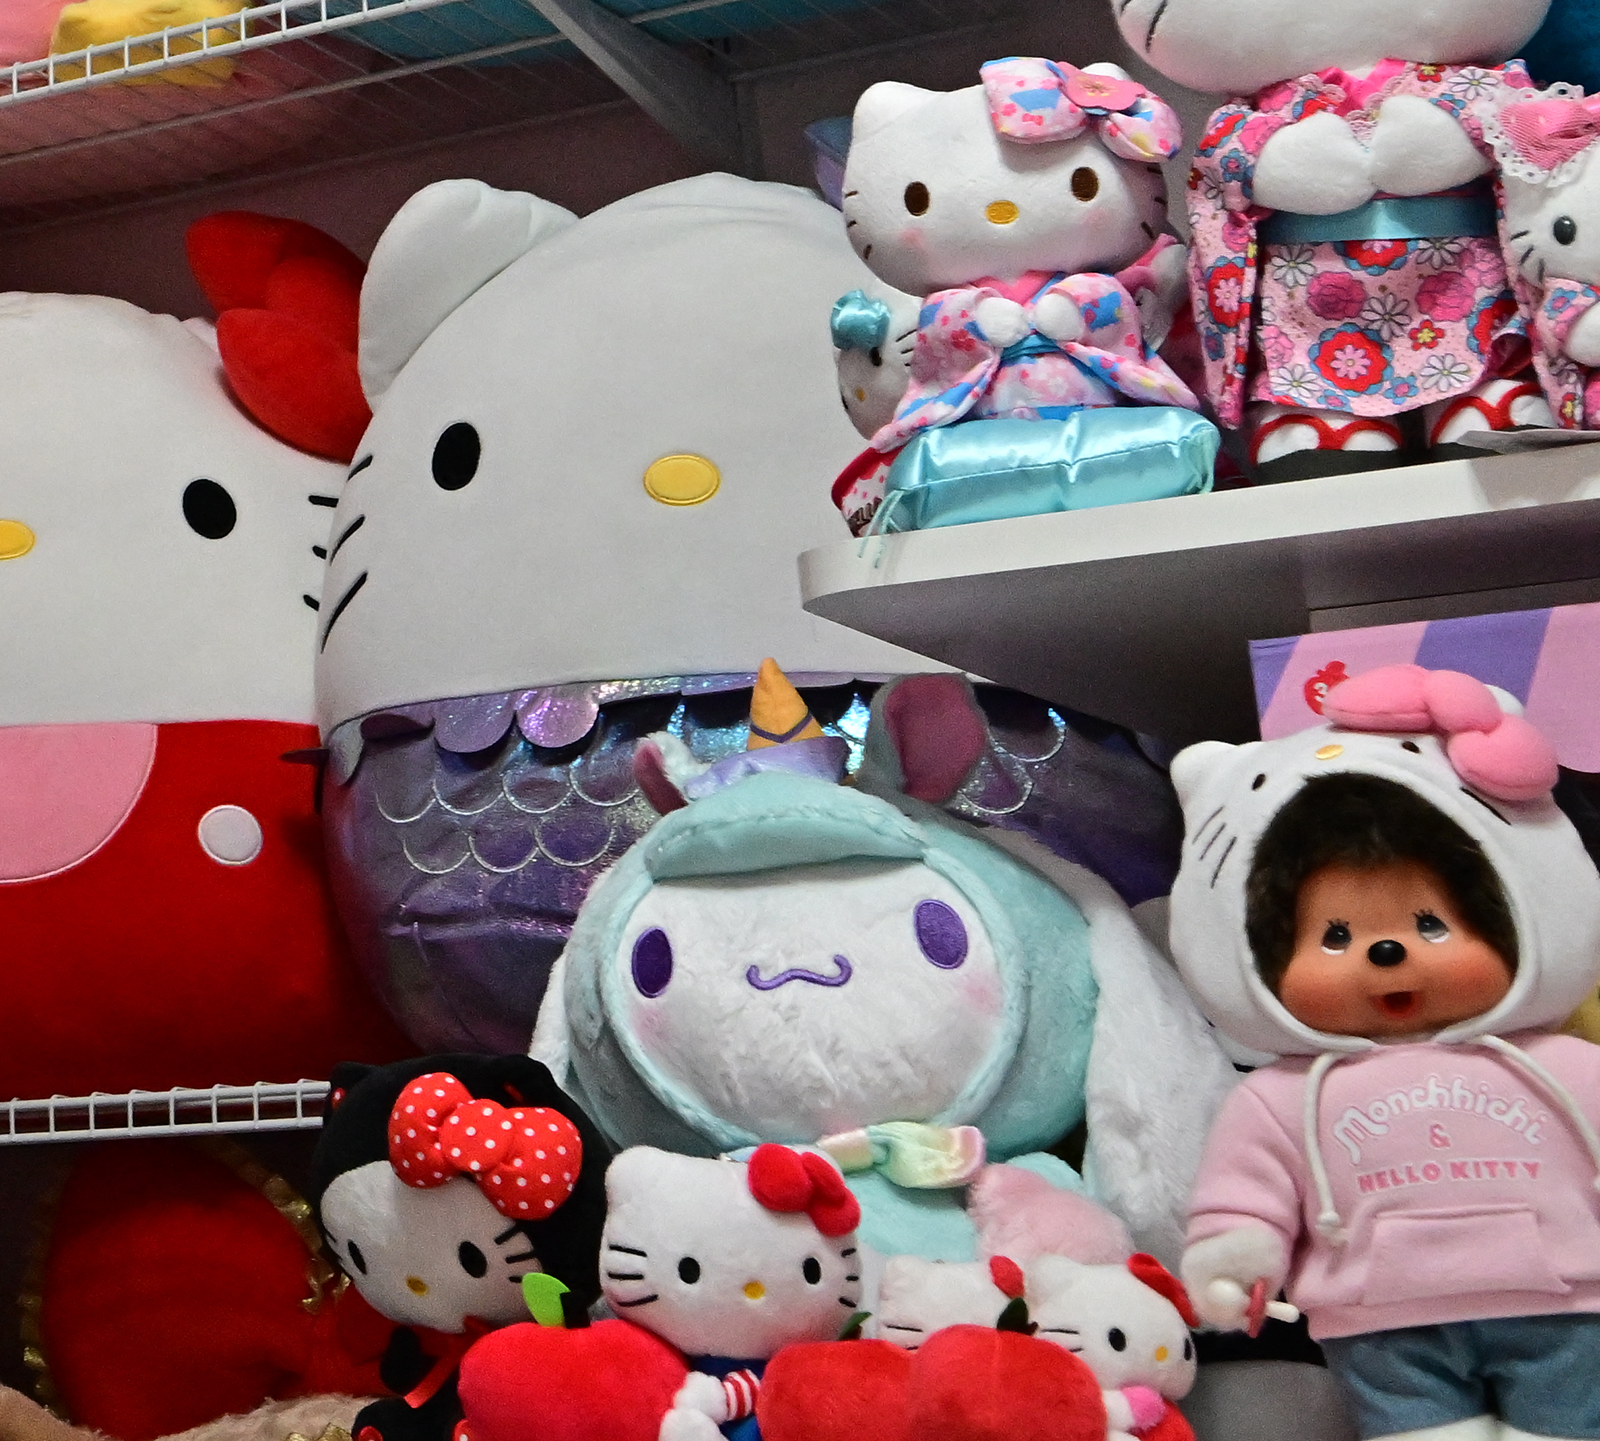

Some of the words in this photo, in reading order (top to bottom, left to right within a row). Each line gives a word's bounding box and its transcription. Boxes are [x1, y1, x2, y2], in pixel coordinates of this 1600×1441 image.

[1334, 1075, 1549, 1166] Monchhichi
[1428, 1123, 1451, 1149] &
[1357, 1162, 1442, 1193] HELLO
[1449, 1160, 1541, 1182] KITTY
